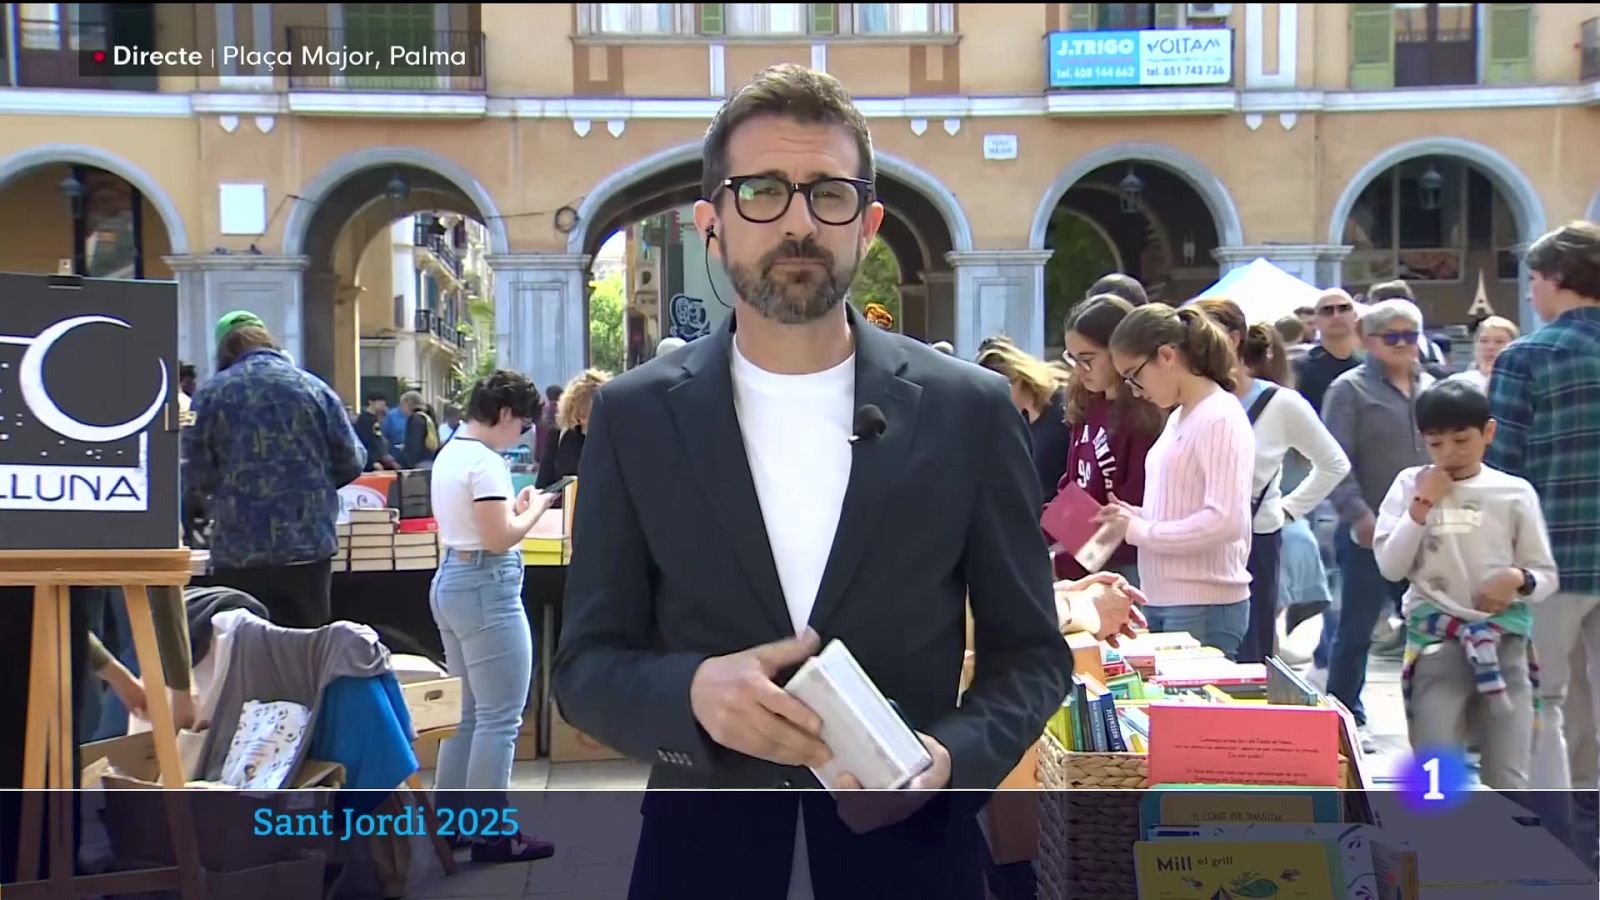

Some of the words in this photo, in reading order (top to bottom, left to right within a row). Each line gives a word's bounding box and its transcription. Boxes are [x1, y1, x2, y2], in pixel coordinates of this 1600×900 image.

[1056, 39, 1135, 56] J.TRIGO
[1147, 38, 1221, 54] VOLTAM
[1157, 856, 1192, 871] Mill
[1211, 856, 1233, 868] grill
